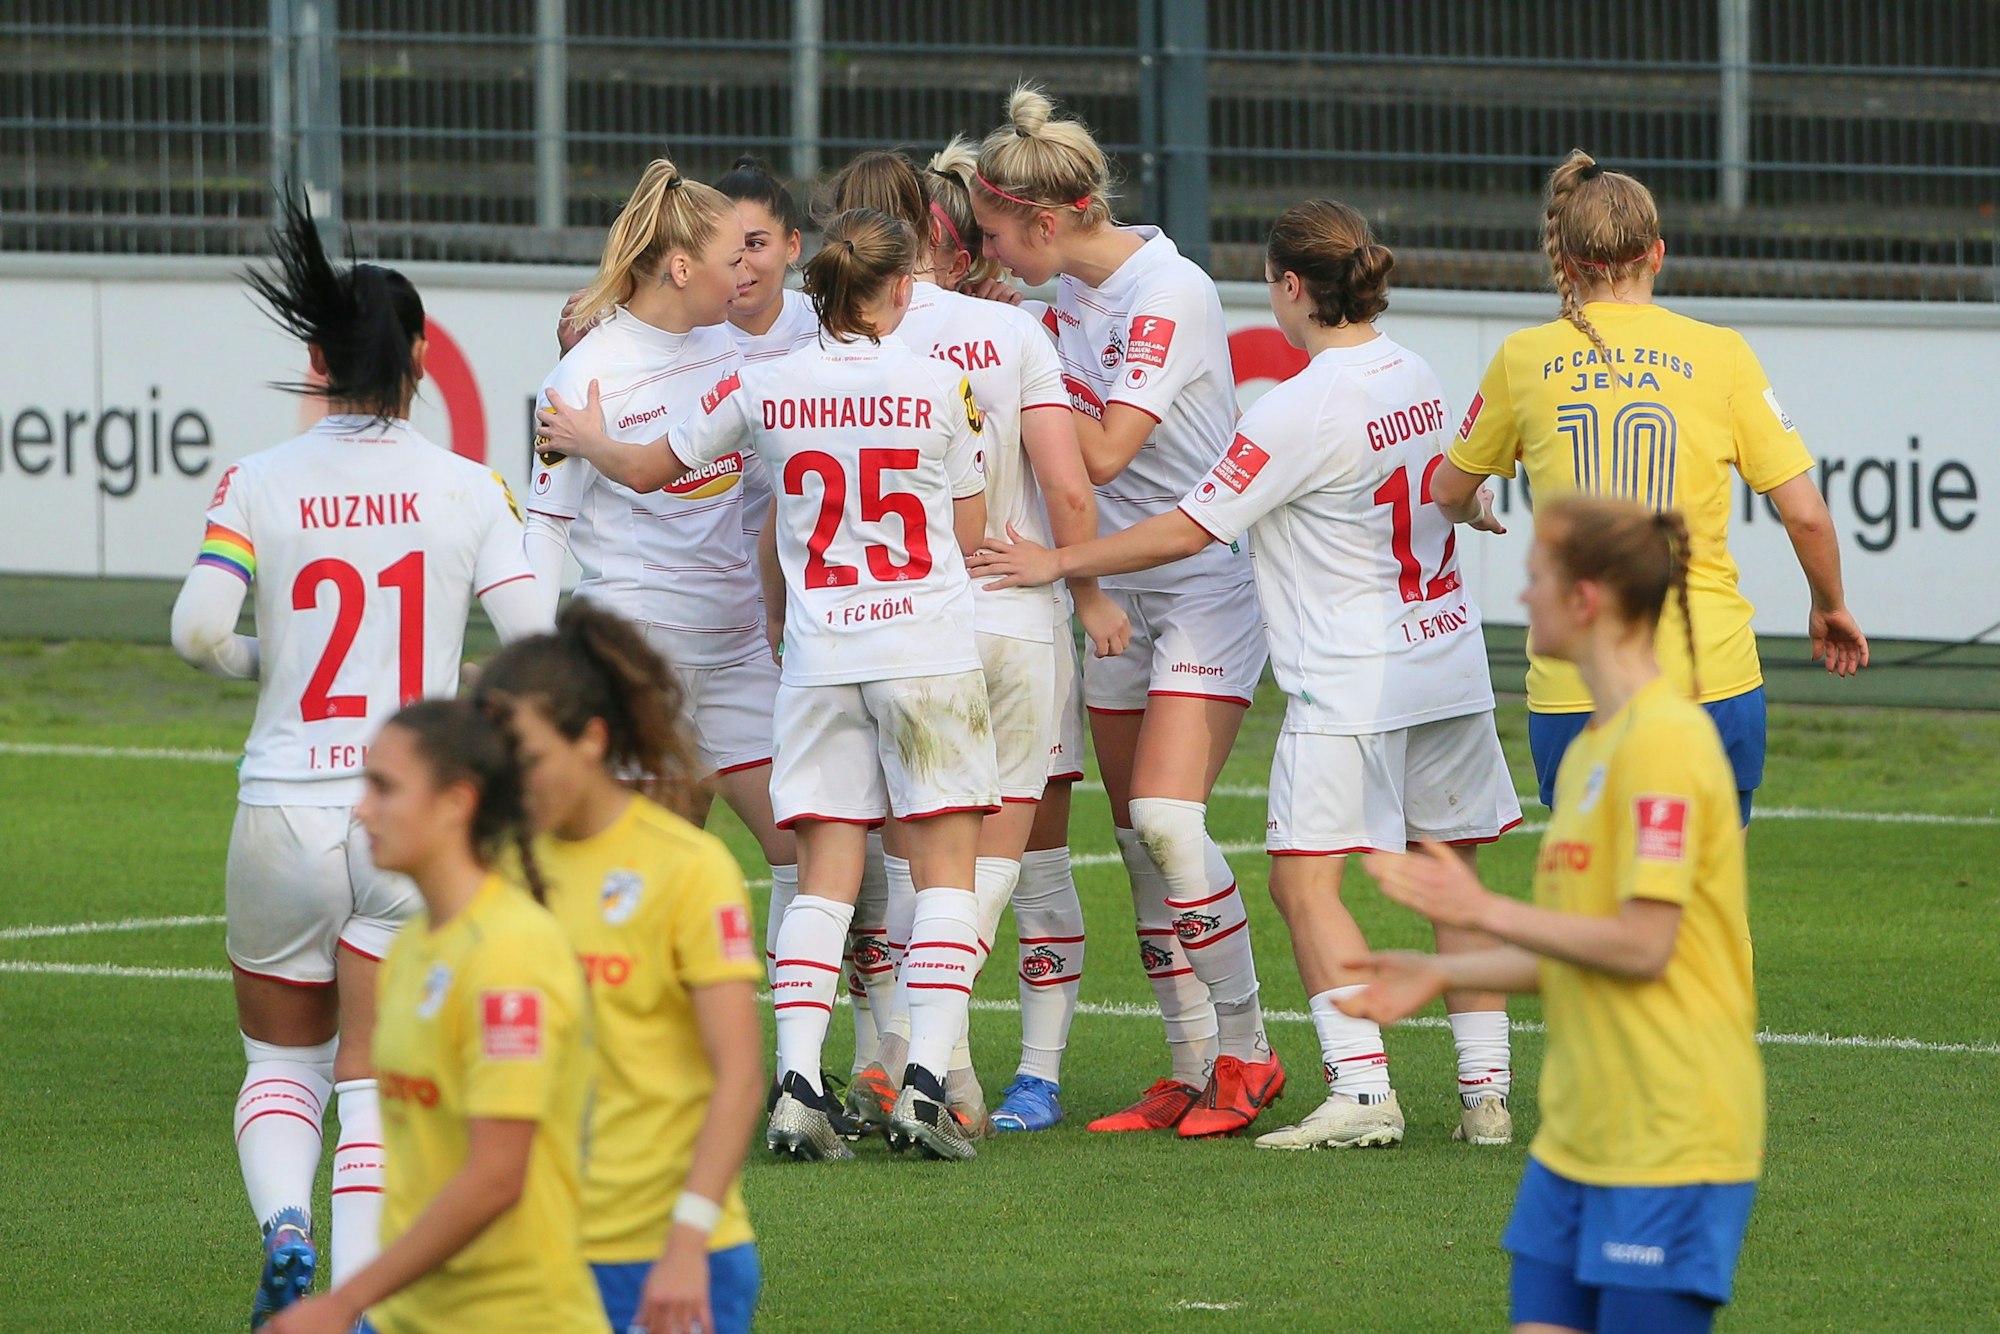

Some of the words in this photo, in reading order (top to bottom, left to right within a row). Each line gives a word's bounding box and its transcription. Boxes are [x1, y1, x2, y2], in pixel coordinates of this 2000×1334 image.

[929, 340, 1001, 371] SKA
[1544, 356, 1564, 380] FC
[1572, 348, 1625, 367] CARL
[1634, 348, 1693, 379] ZEISS
[1570, 372, 1660, 392] JENA
[618, 405, 668, 429] uhlsport
[762, 396, 932, 430] DONHAUSER
[1366, 399, 1444, 452] GUDORF
[0, 386, 210, 497] ergie
[1557, 402, 1677, 513] 10
[300, 493, 420, 529] KUZNIK
[783, 448, 932, 590] 25
[844, 604, 866, 625] FC
[870, 596, 914, 620] KÖLN
[292, 551, 424, 722] 21
[1401, 623, 1417, 642] 1.
[1171, 661, 1224, 677] uhlsport
[309, 746, 322, 769] 1.
[330, 745, 356, 769] FC
[908, 961, 966, 972] uhlsport
